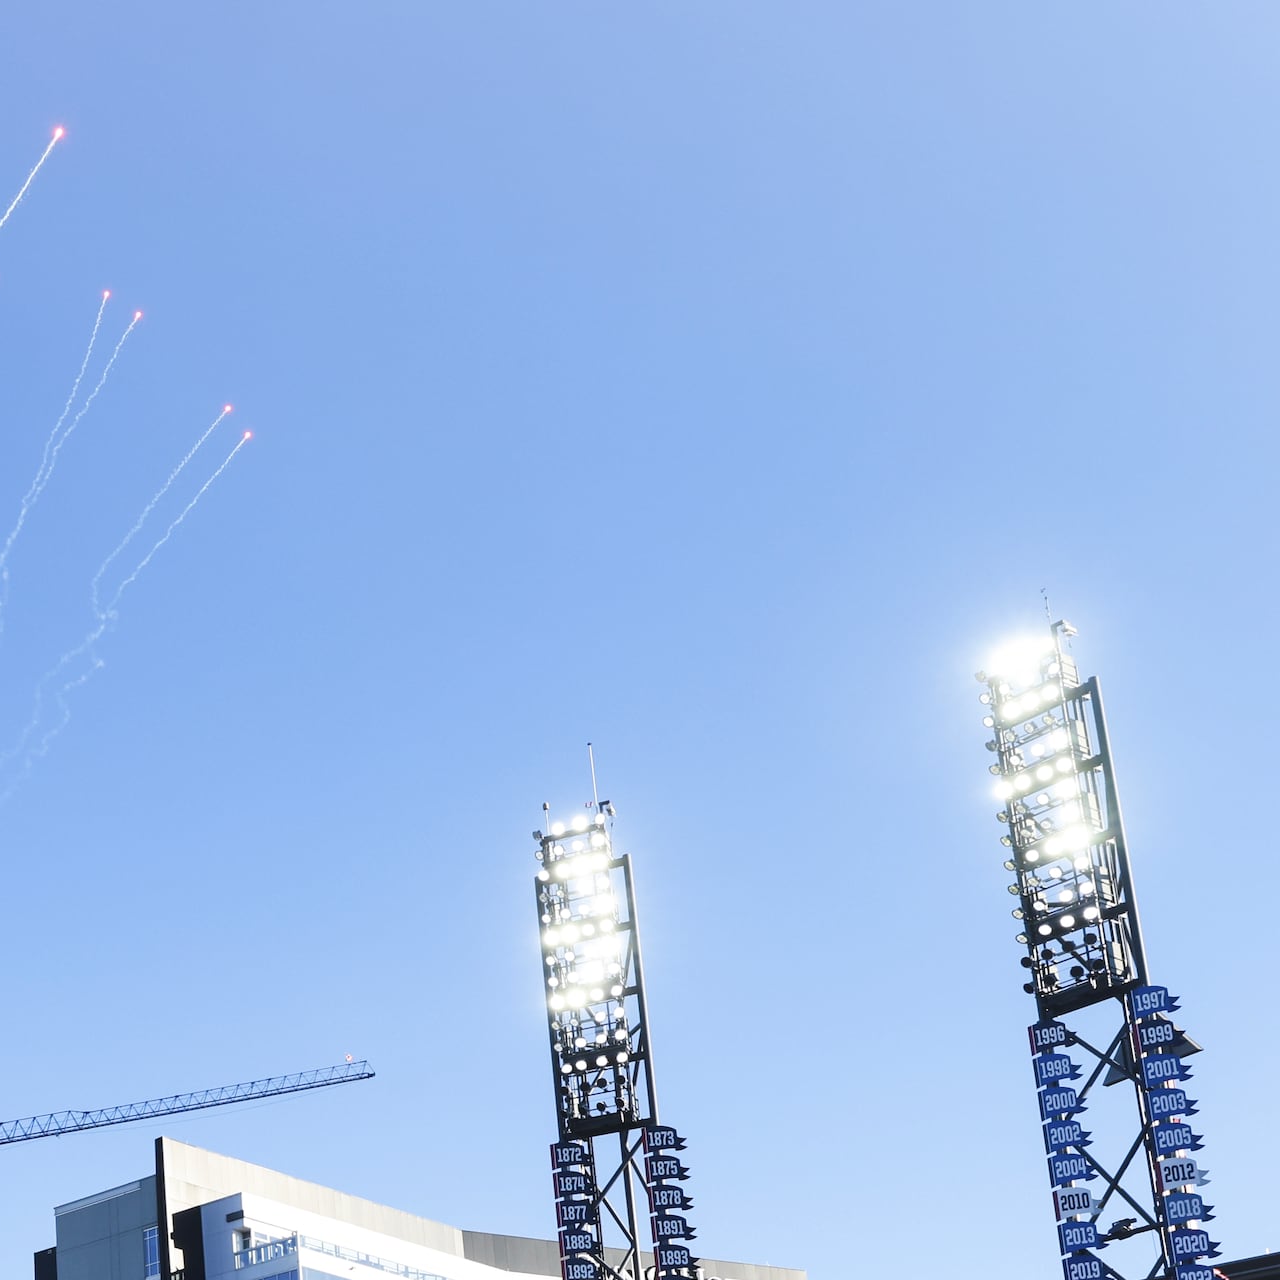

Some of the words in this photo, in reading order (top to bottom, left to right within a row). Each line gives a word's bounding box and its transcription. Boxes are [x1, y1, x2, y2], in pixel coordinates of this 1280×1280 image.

[1135, 990, 1165, 1011] 1997
[1035, 1025, 1066, 1046] 1996
[1141, 1023, 1173, 1045] 1999
[1040, 1058, 1071, 1079] 1998
[1146, 1058, 1179, 1079] 2001
[1045, 1091, 1077, 1111] 2000
[1152, 1092, 1186, 1114] 2003
[648, 1130, 675, 1146] 1873
[1050, 1124, 1082, 1145] 2002
[1158, 1127, 1192, 1148] 2005
[556, 1148, 582, 1162] 1872
[651, 1160, 678, 1176] 1875
[1055, 1157, 1087, 1178] 2004
[1164, 1163, 1195, 1183] 2012
[559, 1176, 586, 1191] 1874
[654, 1190, 682, 1206] 1878
[1060, 1192, 1090, 1211] 2010
[562, 1205, 586, 1221] 1877
[1169, 1198, 1201, 1219] 2018
[657, 1219, 684, 1235] 1891
[1065, 1227, 1095, 1246] 2013
[565, 1235, 592, 1250] 1883
[1174, 1234, 1209, 1254] 2020
[660, 1250, 689, 1266] 1893
[567, 1264, 594, 1279] 1892
[1070, 1261, 1101, 1280] 2019
